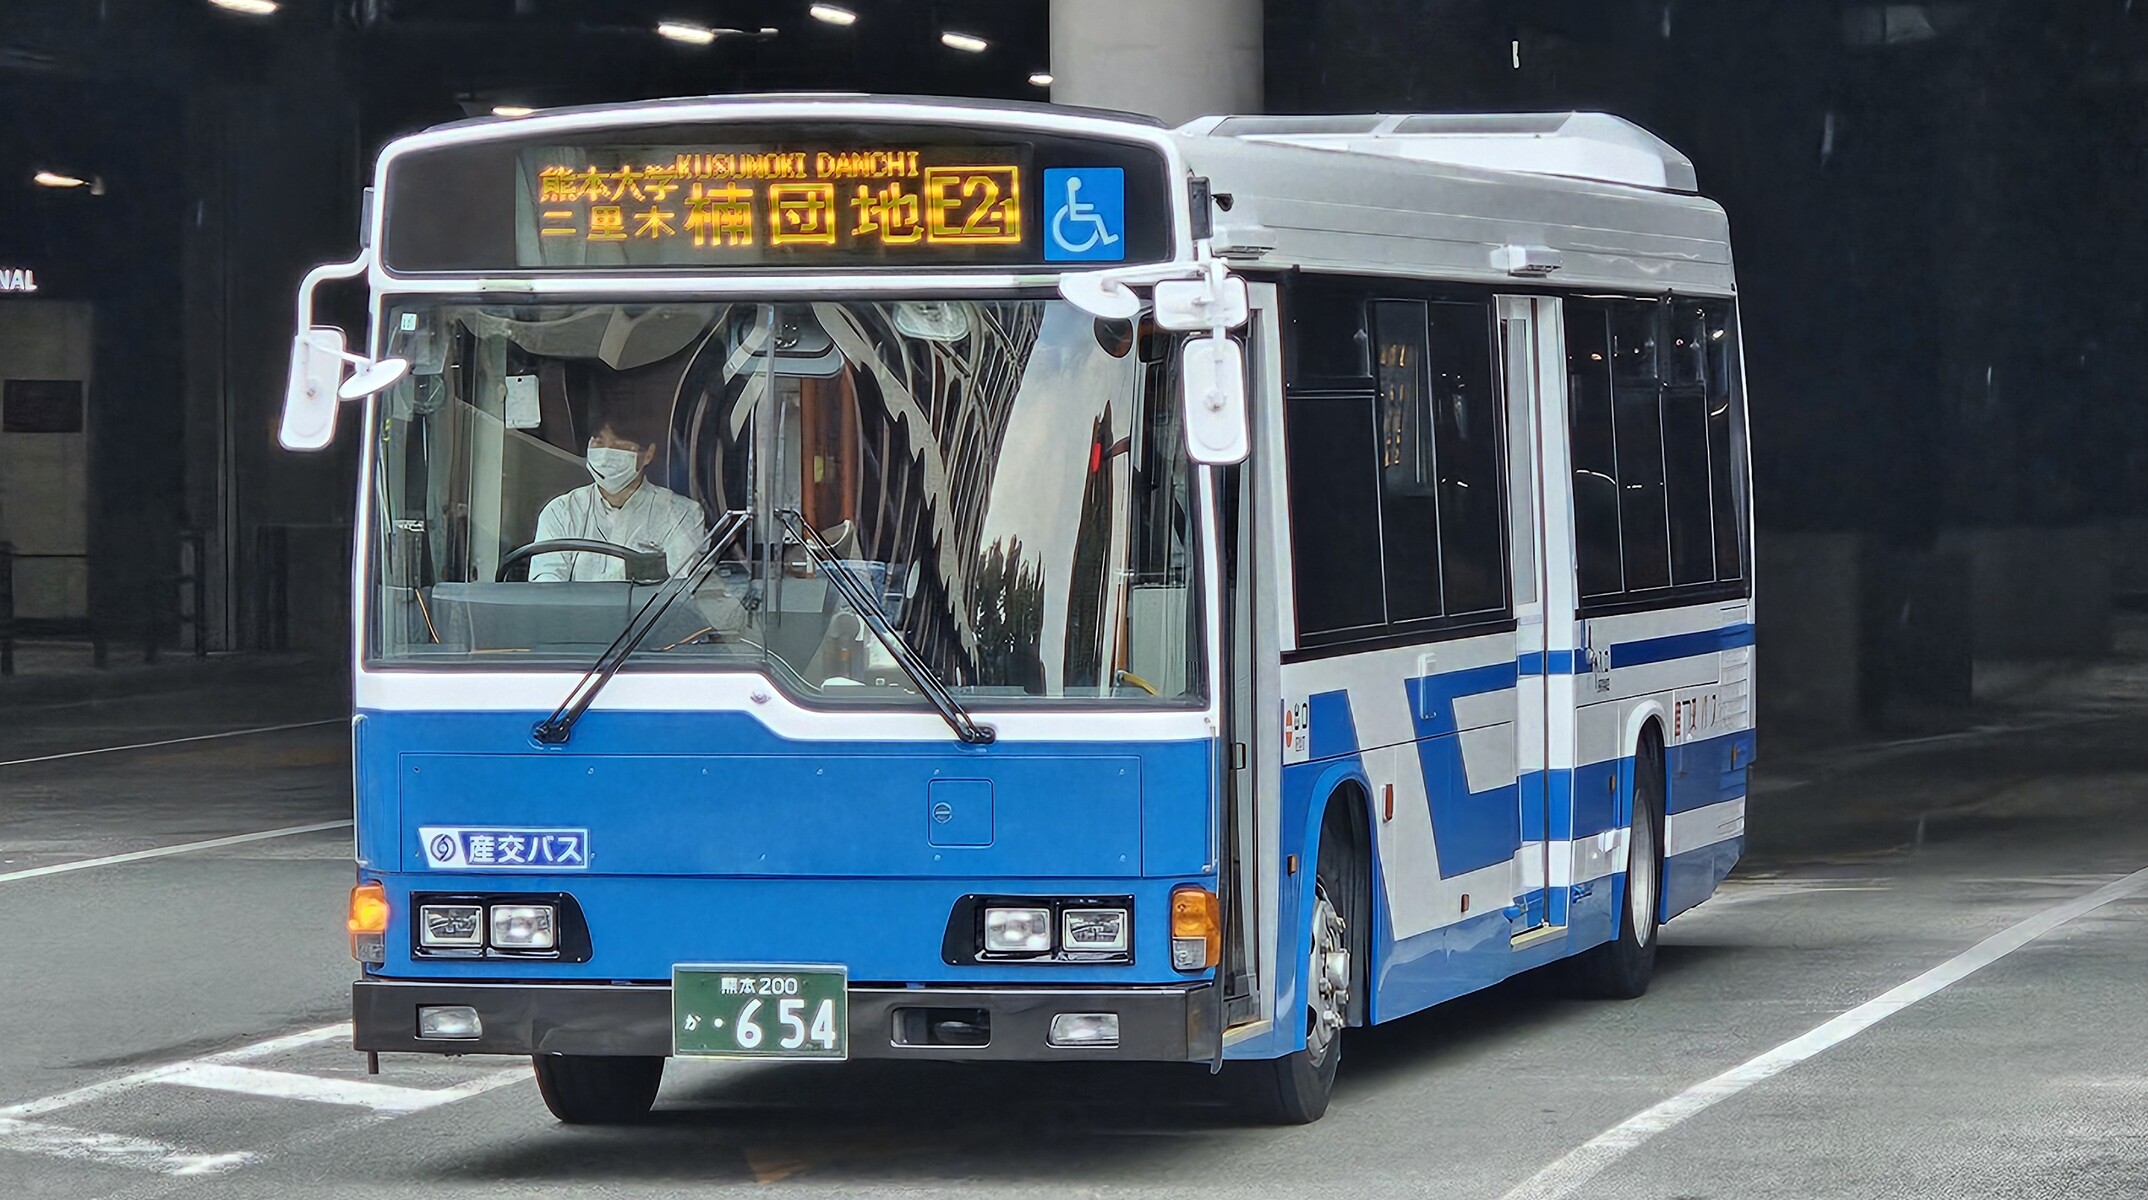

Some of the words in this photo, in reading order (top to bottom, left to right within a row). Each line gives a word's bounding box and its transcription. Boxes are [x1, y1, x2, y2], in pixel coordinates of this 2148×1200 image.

[676, 153, 807, 180] KUSUNOKI
[816, 151, 919, 178] DANCHI
[540, 165, 678, 202] 熊本大学
[684, 181, 925, 245] 楠団地
[468, 835, 583, 863] 産交バス
